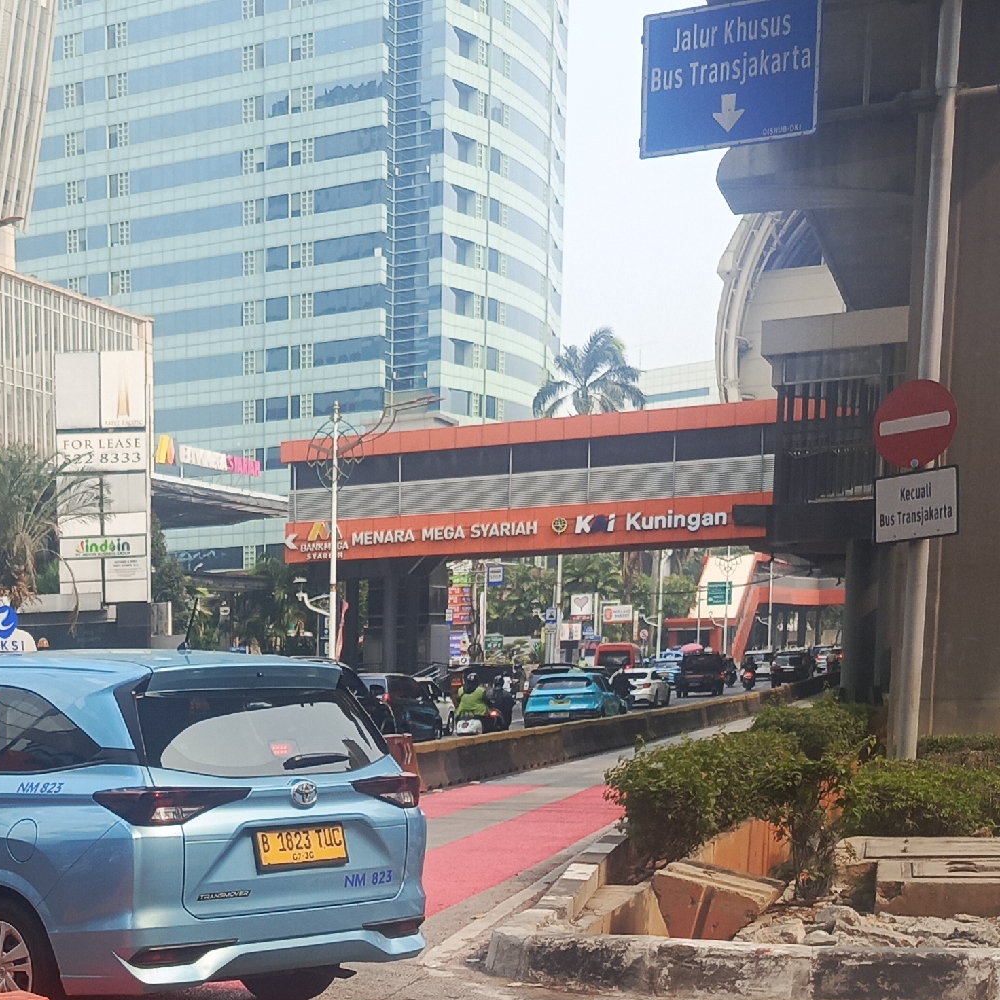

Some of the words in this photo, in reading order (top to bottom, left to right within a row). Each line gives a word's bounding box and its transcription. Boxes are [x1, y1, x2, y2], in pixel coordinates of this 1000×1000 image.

[673, 23, 718, 53] Jalur
[724, 14, 791, 45] Khusus
[651, 67, 683, 92] Bus
[690, 45, 811, 85] Transjakarta
[63, 439, 94, 450] FOR
[99, 438, 141, 449] LEASE
[65, 453, 95, 464] 522
[100, 452, 141, 464] 8333
[900, 482, 932, 501] Kecuali
[626, 509, 727, 532] Kuningan
[880, 513, 895, 528] Bus
[897, 505, 953, 526] Transjakarta
[351, 528, 415, 547] MENARA
[422, 525, 466, 542] MEGA
[470, 520, 538, 539] SYARIAH
[306, 551, 343, 560] SYARIH
[16, 777, 40, 793] NM
[40, 777, 65, 793] 823
[261, 833, 270, 853] B
[277, 831, 311, 851] 1823
[315, 827, 343, 848] TUC
[344, 874, 366, 889] NM
[371, 870, 393, 886] 823
